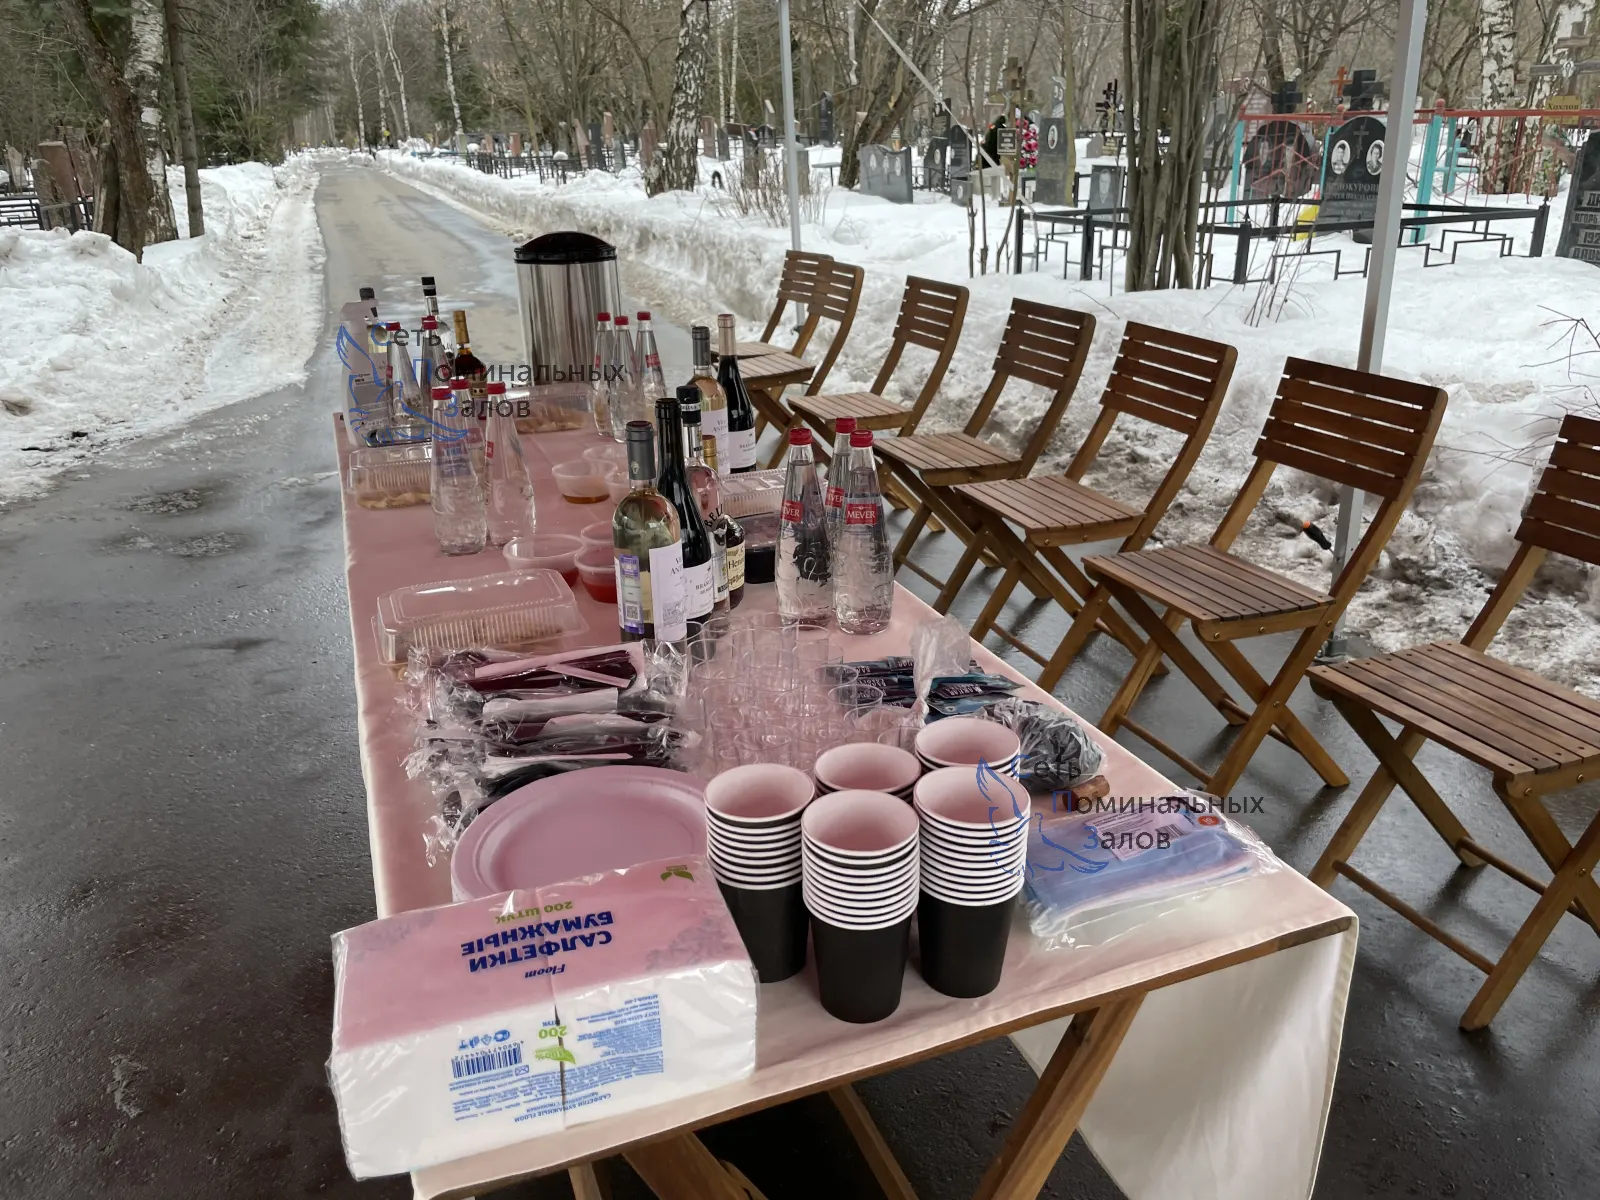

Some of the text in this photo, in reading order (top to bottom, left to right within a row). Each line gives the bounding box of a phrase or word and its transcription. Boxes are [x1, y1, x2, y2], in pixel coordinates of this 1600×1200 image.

[847, 511, 875, 519] MEVER
[543, 900, 573, 914] 200
[460, 910, 614, 957] БУМАЖНЫЕ
[468, 930, 613, 973] САЛФЕТКИ
[524, 963, 566, 979] Floom
[538, 1025, 567, 1039] 200
